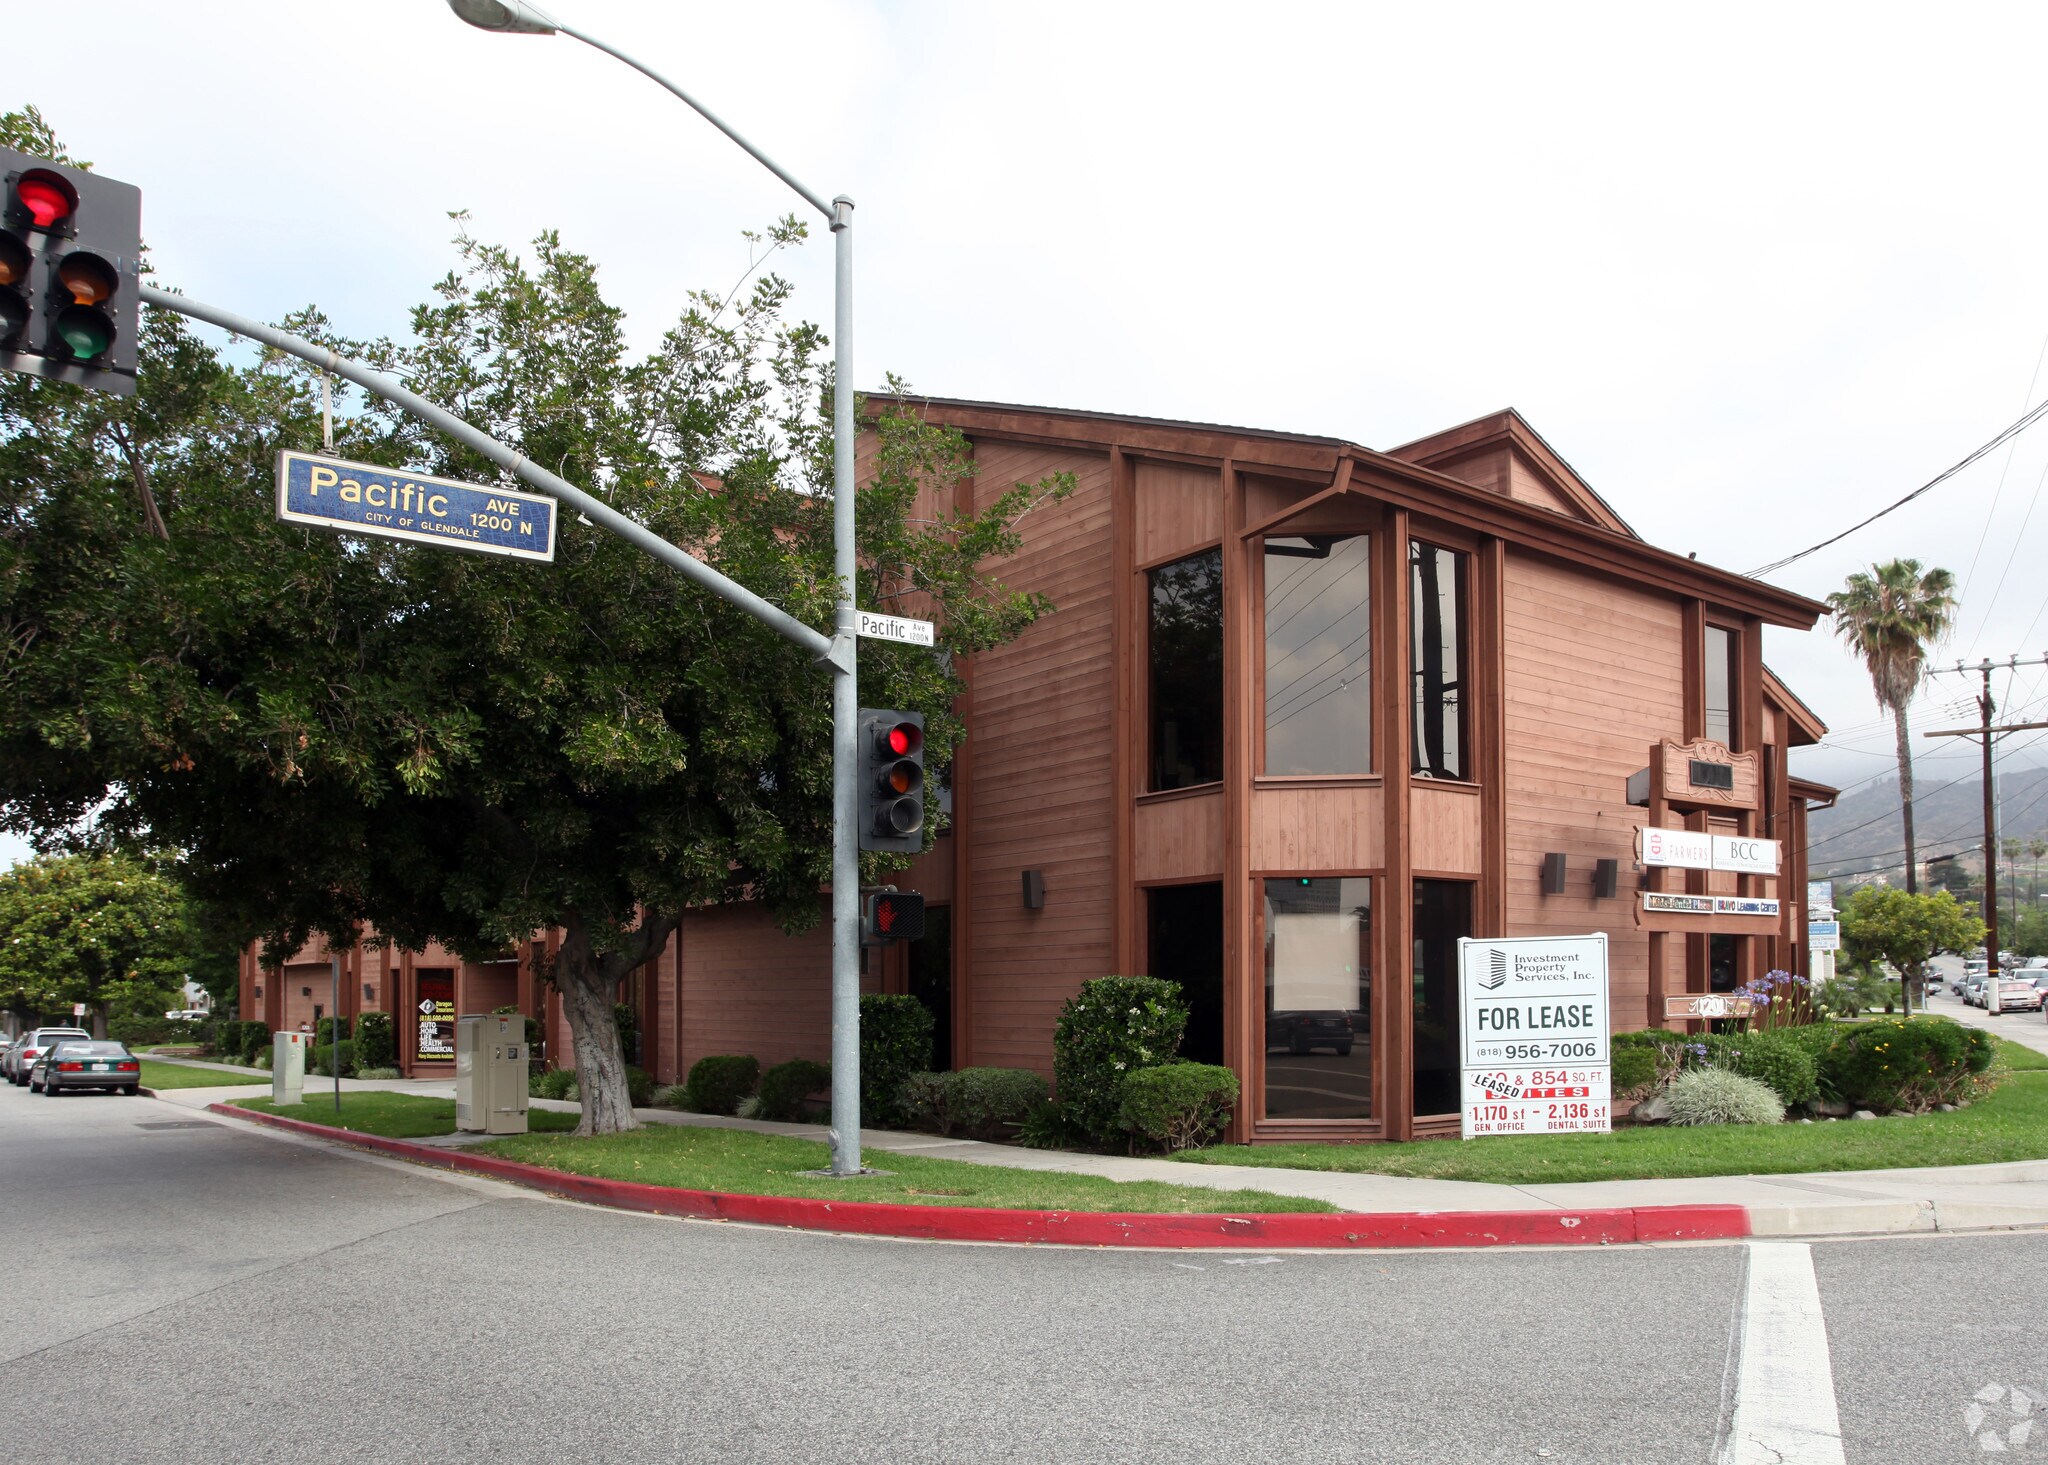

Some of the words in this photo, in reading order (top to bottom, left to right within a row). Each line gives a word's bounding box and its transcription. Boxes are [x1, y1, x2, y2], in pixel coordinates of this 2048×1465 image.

[310, 466, 448, 517] Pacific
[485, 499, 520, 516] AVE
[366, 512, 393, 523] CITY
[399, 517, 414, 527] OF
[421, 521, 480, 538] GLENDALE
[470, 513, 513, 532] 1200
[520, 522, 533, 535] N
[862, 615, 905, 638] Pacific
[912, 623, 926, 632] Ave
[1669, 844, 1709, 861] FARMERS
[1730, 841, 1760, 861] BCC
[1717, 900, 1736, 912] BRAVO
[1760, 902, 1778, 913] CENTER
[1514, 953, 1580, 963] Investment
[1514, 963, 1566, 973] Property
[1514, 972, 1570, 982] Services,
[1573, 971, 1595, 980] Inc.
[1478, 1007, 1520, 1030] FOR
[1528, 1004, 1593, 1029] LEASE
[1477, 1047, 1502, 1058] (818)
[1505, 1042, 1596, 1059] 956-7006
[1474, 1073, 1520, 1099] LEASED
[1514, 1075, 1524, 1086] &
[1532, 1070, 1568, 1085] 854
[1572, 1072, 1589, 1083] SQ.
[1472, 1105, 1508, 1121] 1,170
[1548, 1104, 1589, 1120] 2,136
[1474, 1122, 1494, 1132] GEN.
[1497, 1122, 1525, 1131] OFFICE
[1548, 1120, 1579, 1130] DENTAL
[1583, 1119, 1606, 1129] SUITE
